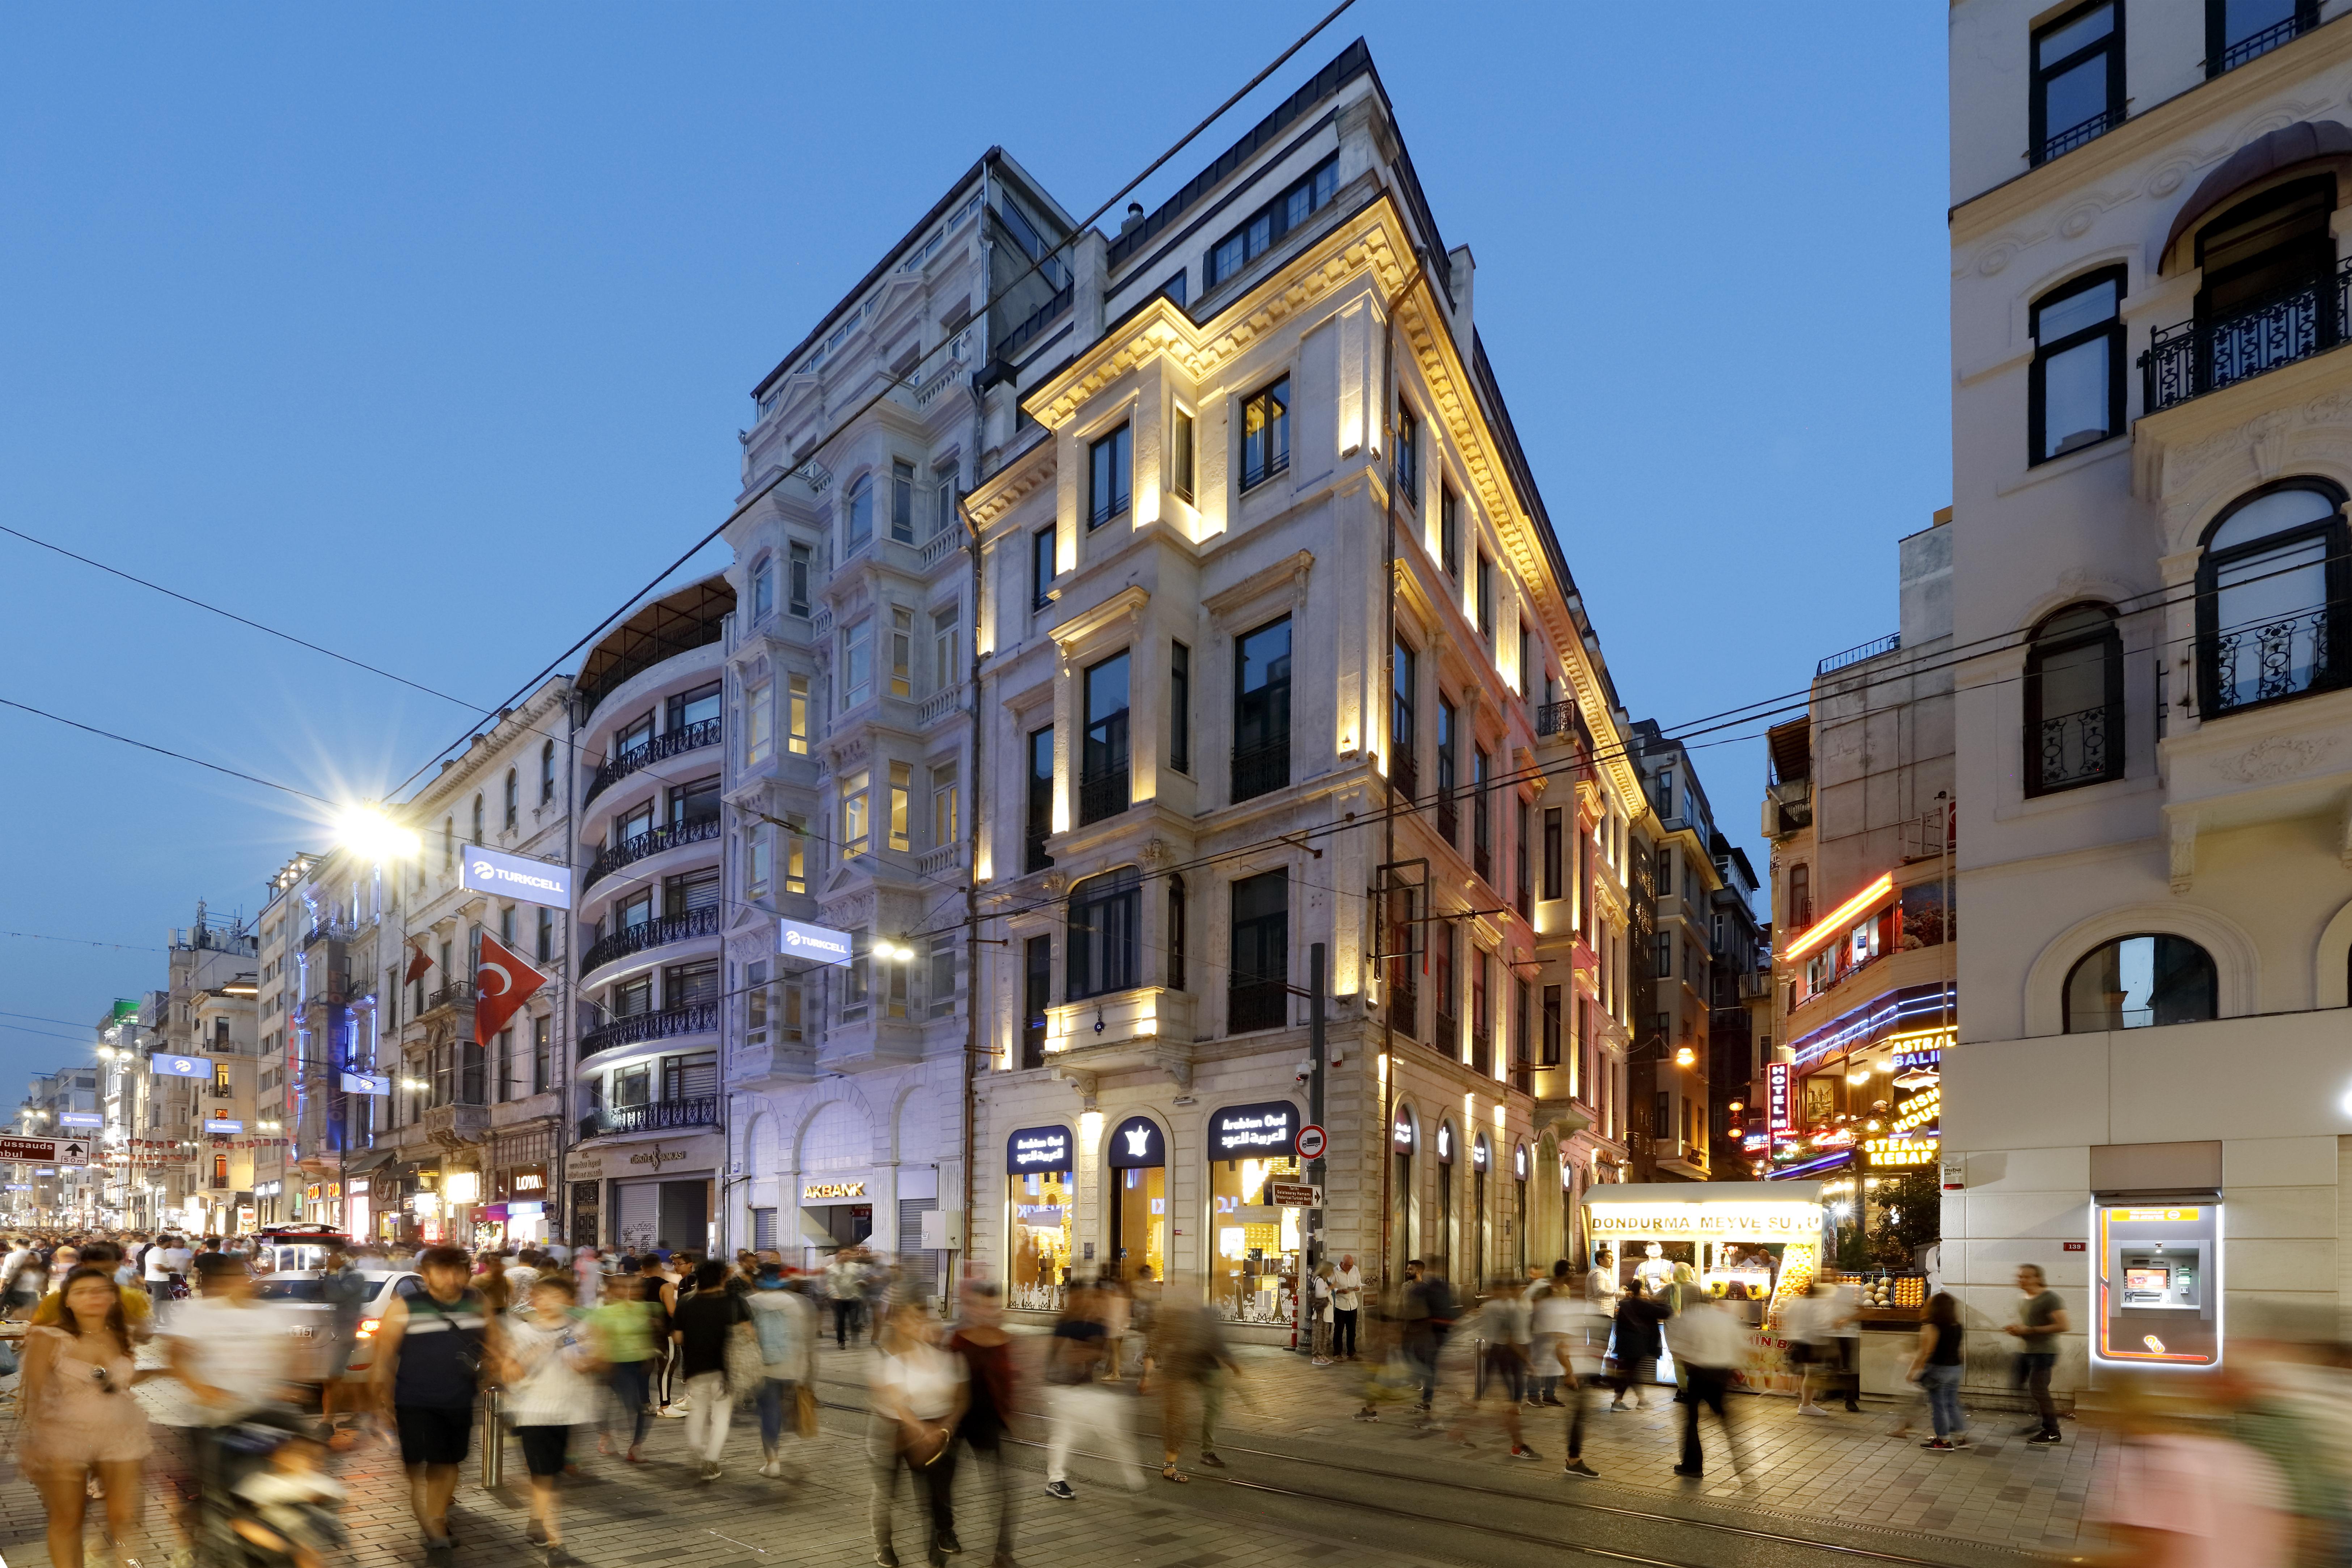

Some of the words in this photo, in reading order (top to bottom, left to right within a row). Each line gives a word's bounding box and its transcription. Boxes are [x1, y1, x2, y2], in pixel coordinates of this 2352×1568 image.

[495, 868, 564, 892] TURKCELL
[801, 936, 847, 954] TURKCELL
[1892, 1035, 1957, 1055] ASTRAL
[1898, 1087, 1940, 1115] FISH
[1222, 1117, 1262, 1130] Arabian
[1264, 1113, 1286, 1127] Oud
[1047, 1135, 1064, 1147] Oud
[1870, 1151, 1932, 1165] KEBAP
[308, 1185, 320, 1200] FLO
[328, 1182, 340, 1197] FLO
[803, 1182, 864, 1199] AKBANK
[1592, 1217, 1690, 1229] DONDURMA
[1701, 1217, 1761, 1228] MEYVE
[1768, 1217, 1819, 1229] SUU
